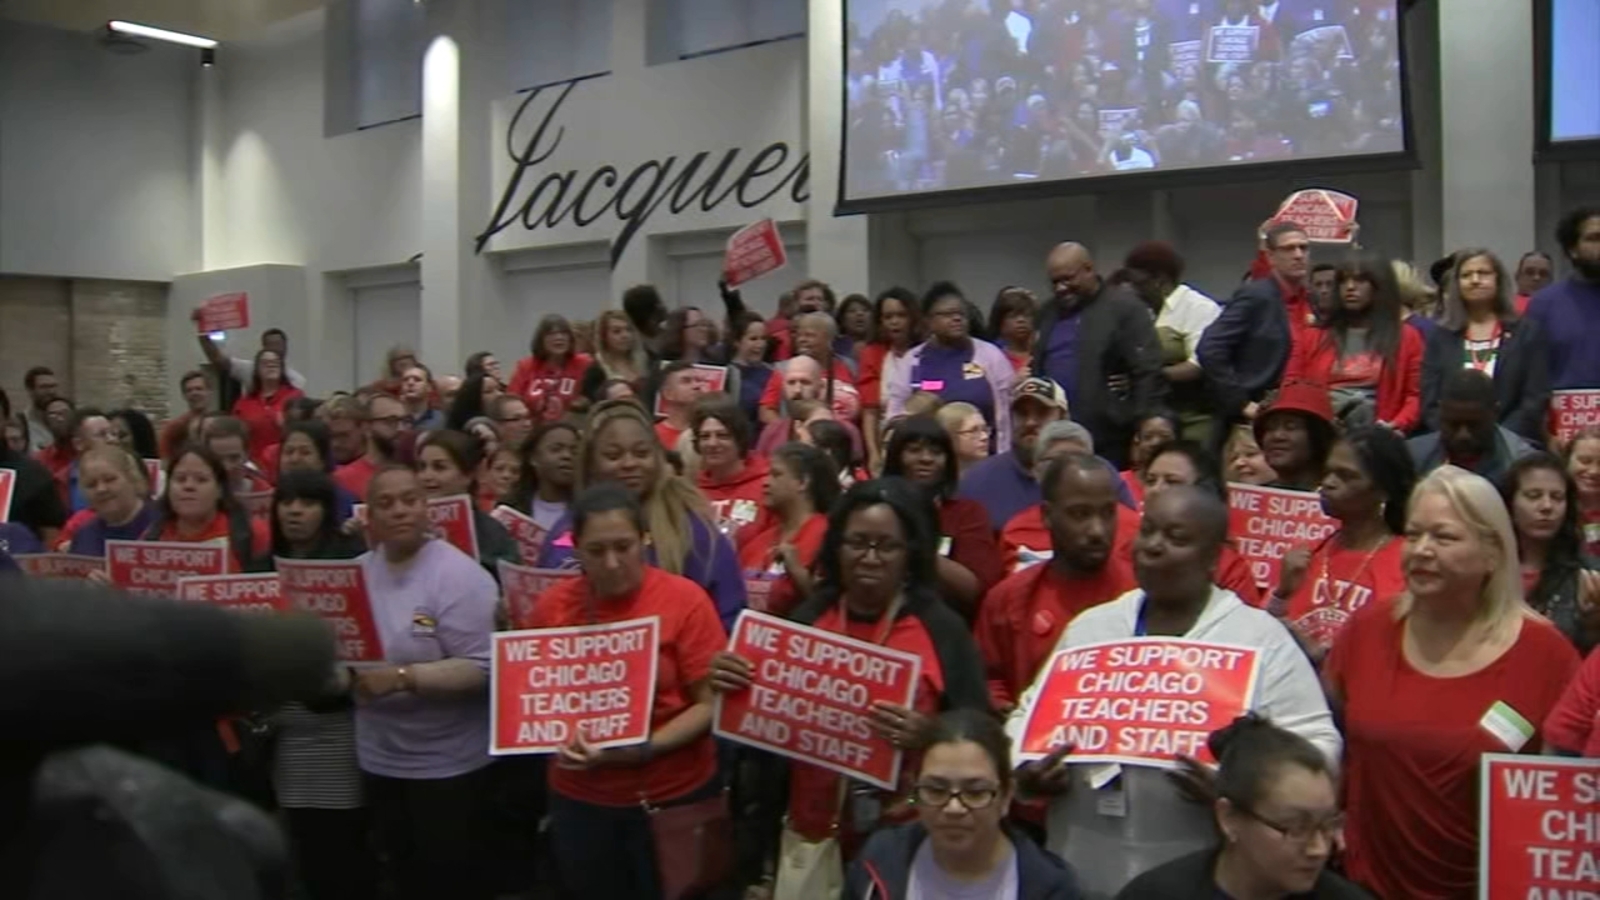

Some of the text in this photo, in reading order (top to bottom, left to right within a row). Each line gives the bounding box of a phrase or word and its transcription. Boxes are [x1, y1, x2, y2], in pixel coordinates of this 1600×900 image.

[1230, 490, 1262, 512] WE
[143, 549, 216, 568] SUPPORT
[1237, 536, 1292, 560] TEAC
[1312, 577, 1373, 611] CTU
[505, 628, 648, 662] WE SUPPORT
[744, 621, 903, 686] WE SUPPORT
[1060, 645, 1244, 671] WE SUPPORT
[528, 659, 627, 688] CHICAGO
[760, 658, 869, 708] CHICAGO
[1077, 671, 1204, 694] CHICAGO
[519, 686, 631, 715] TEACHERS
[750, 683, 872, 739] TEACHERS
[1060, 698, 1210, 725] TEACHERS
[516, 720, 568, 743] AND
[738, 712, 873, 767] AND STAFF
[1046, 724, 1209, 758] AND STAFF
[1503, 768, 1600, 804] WE S
